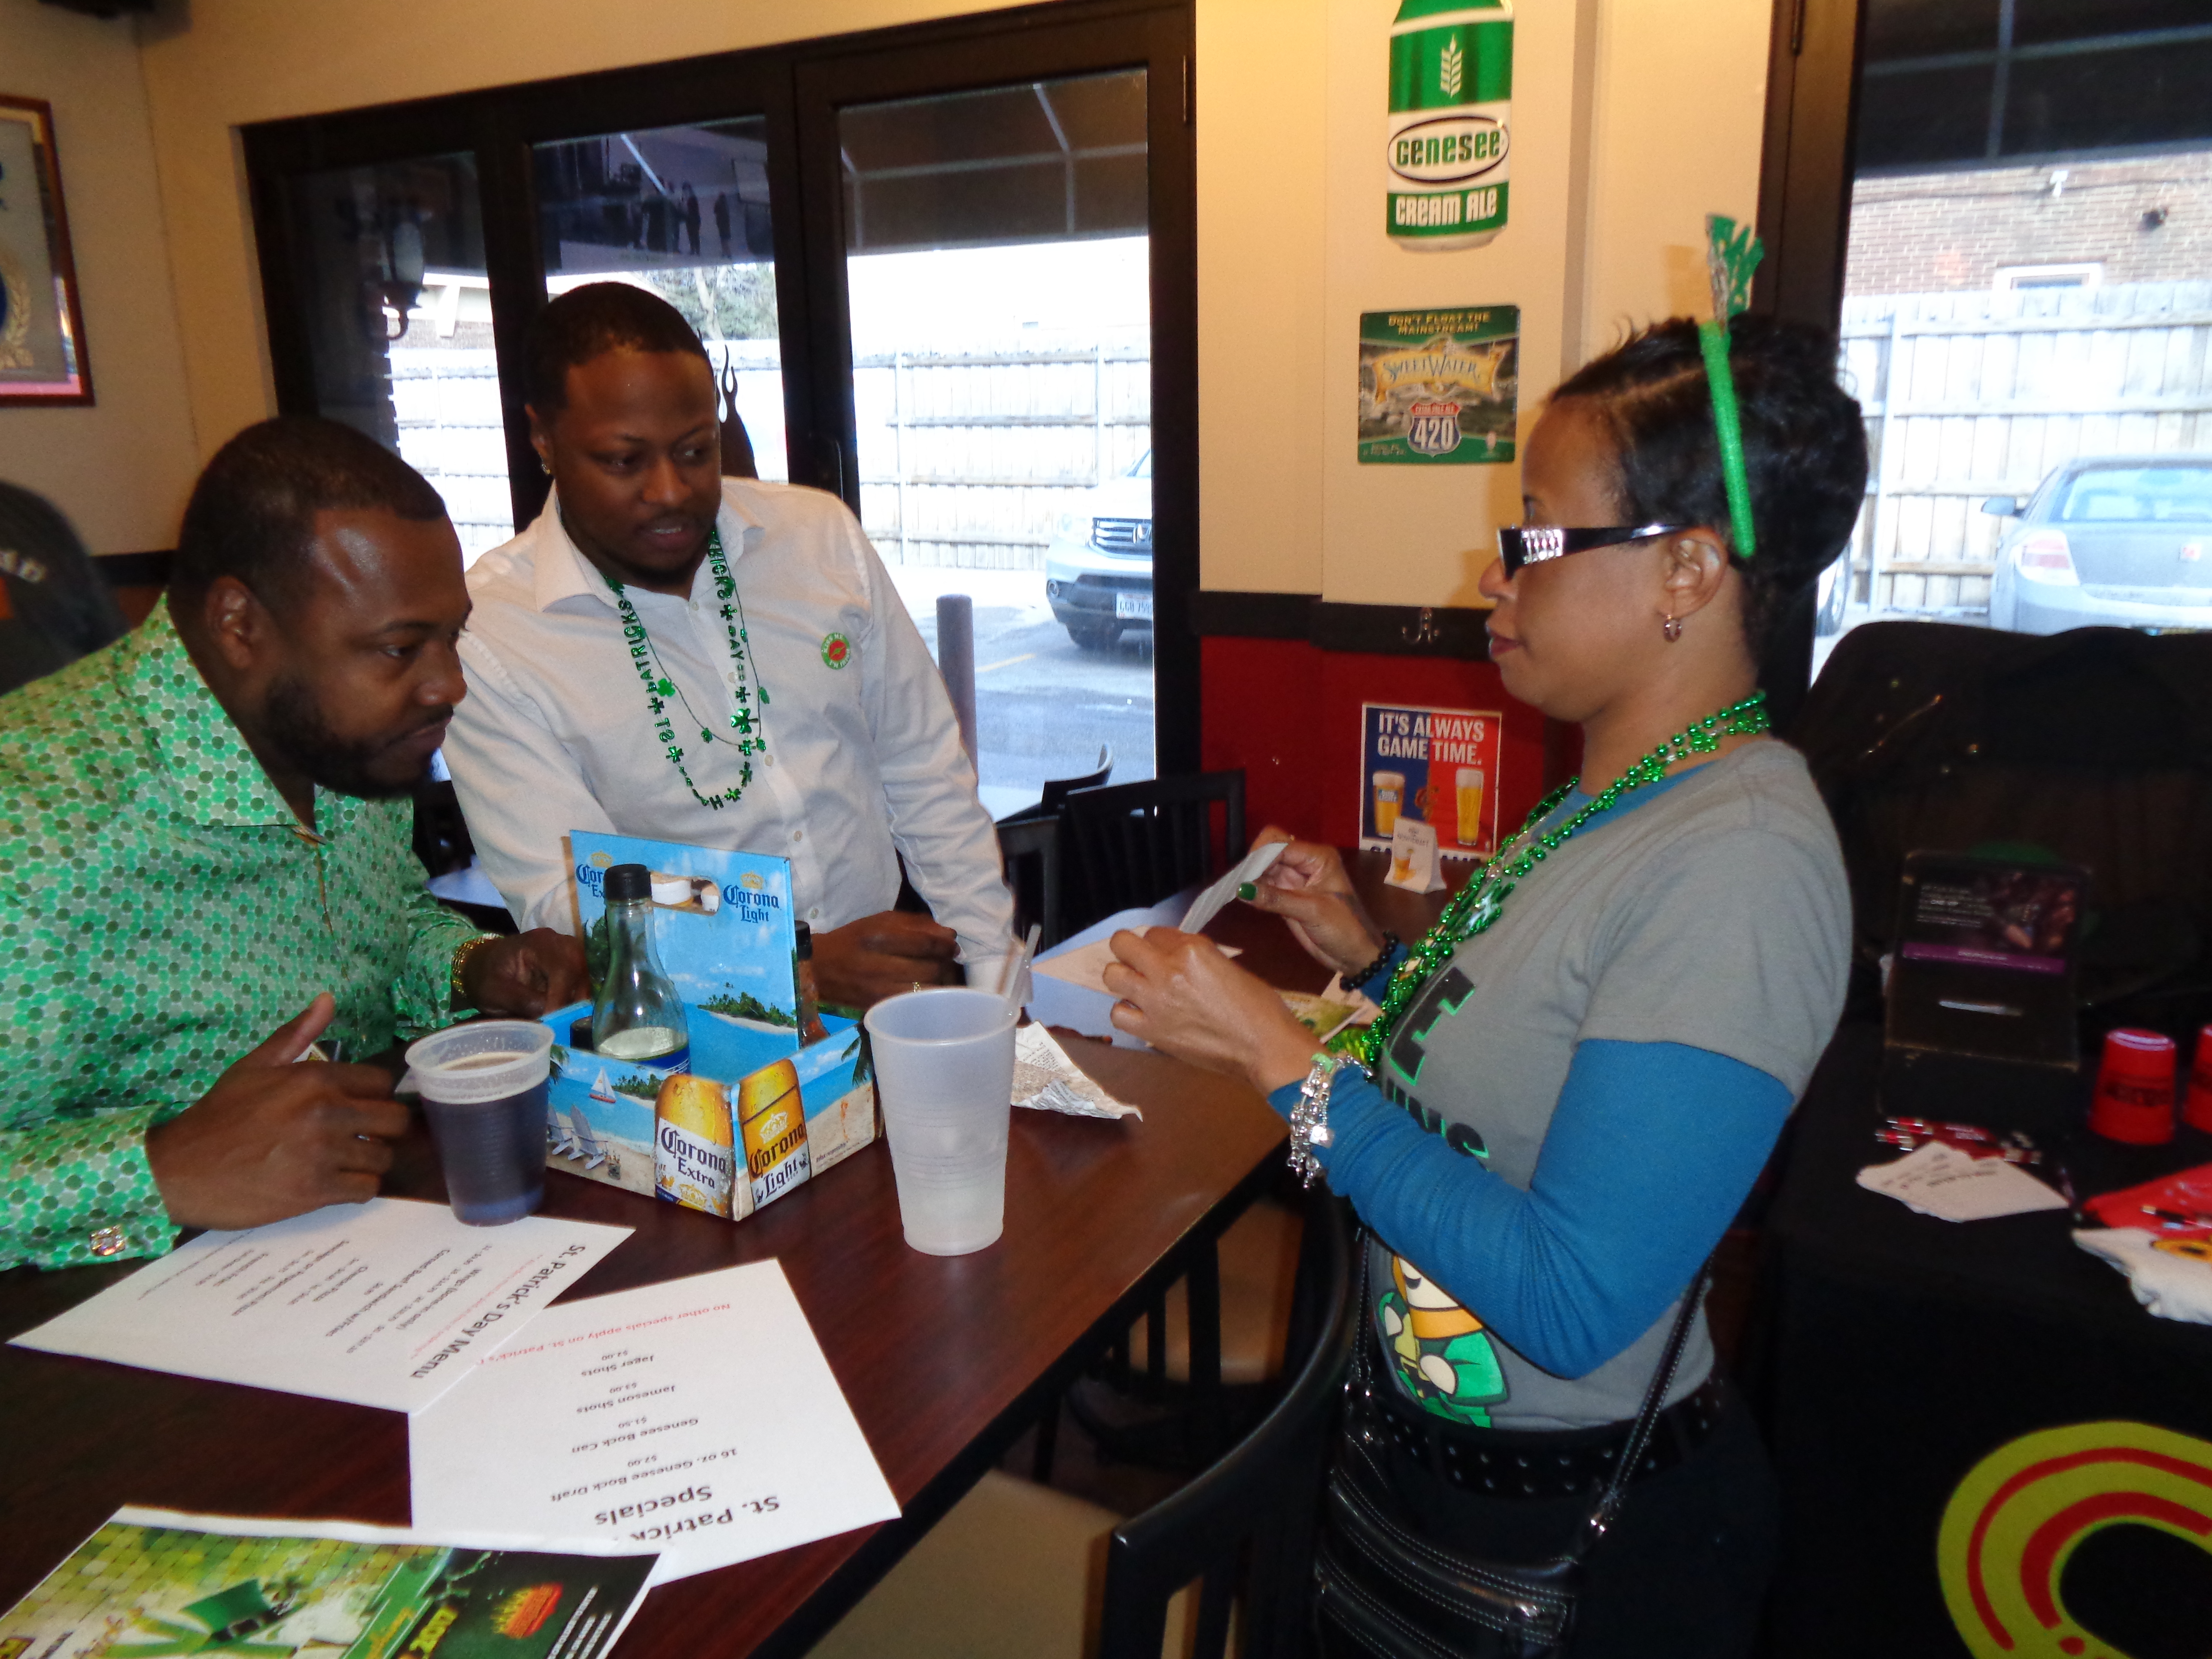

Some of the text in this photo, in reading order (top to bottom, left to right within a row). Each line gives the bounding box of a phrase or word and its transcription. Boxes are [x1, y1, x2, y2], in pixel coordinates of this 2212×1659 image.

[1395, 188, 1498, 227] CREAM ALE
[1426, 313, 1464, 325] FLOAT
[1468, 312, 1490, 322] THE
[1414, 418, 1454, 450] 420
[1378, 711, 1485, 743] IT'S ALWAYS
[1377, 735, 1483, 766] GAME TIME.
[576, 864, 605, 887] Cor
[723, 884, 780, 909] Corona
[740, 905, 769, 924] Light
[661, 1127, 726, 1175] Corona
[749, 1123, 807, 1179] Corona
[677, 1156, 715, 1189] Extra
[763, 1157, 798, 1200] Light
[419, 1249, 450, 1269] Corned
[401, 1270, 422, 1284] Beef
[454, 1269, 481, 1287] Wings
[359, 1284, 402, 1312] Sandwich
[410, 1245, 586, 1378] St. Patrick's Day Menu
[626, 1316, 673, 1331] specials
[678, 1308, 710, 1319] other
[547, 1340, 565, 1349] St.
[588, 1328, 622, 1339] apply
[489, 1345, 544, 1361] Patrick's
[581, 1354, 655, 1376] Jager Shots
[601, 1350, 628, 1361] $2.00
[577, 1385, 675, 1413] Jameson Shots
[609, 1382, 637, 1394] $3.00
[618, 1416, 647, 1428] $1.50
[572, 1419, 699, 1453] Genesee Bock Can
[627, 1455, 657, 1467] $2.00
[552, 1449, 736, 1501] 16 oz. Genesee Bock Draft
[595, 1486, 712, 1525] Specials
[613, 1496, 780, 1544] St. Patrick
